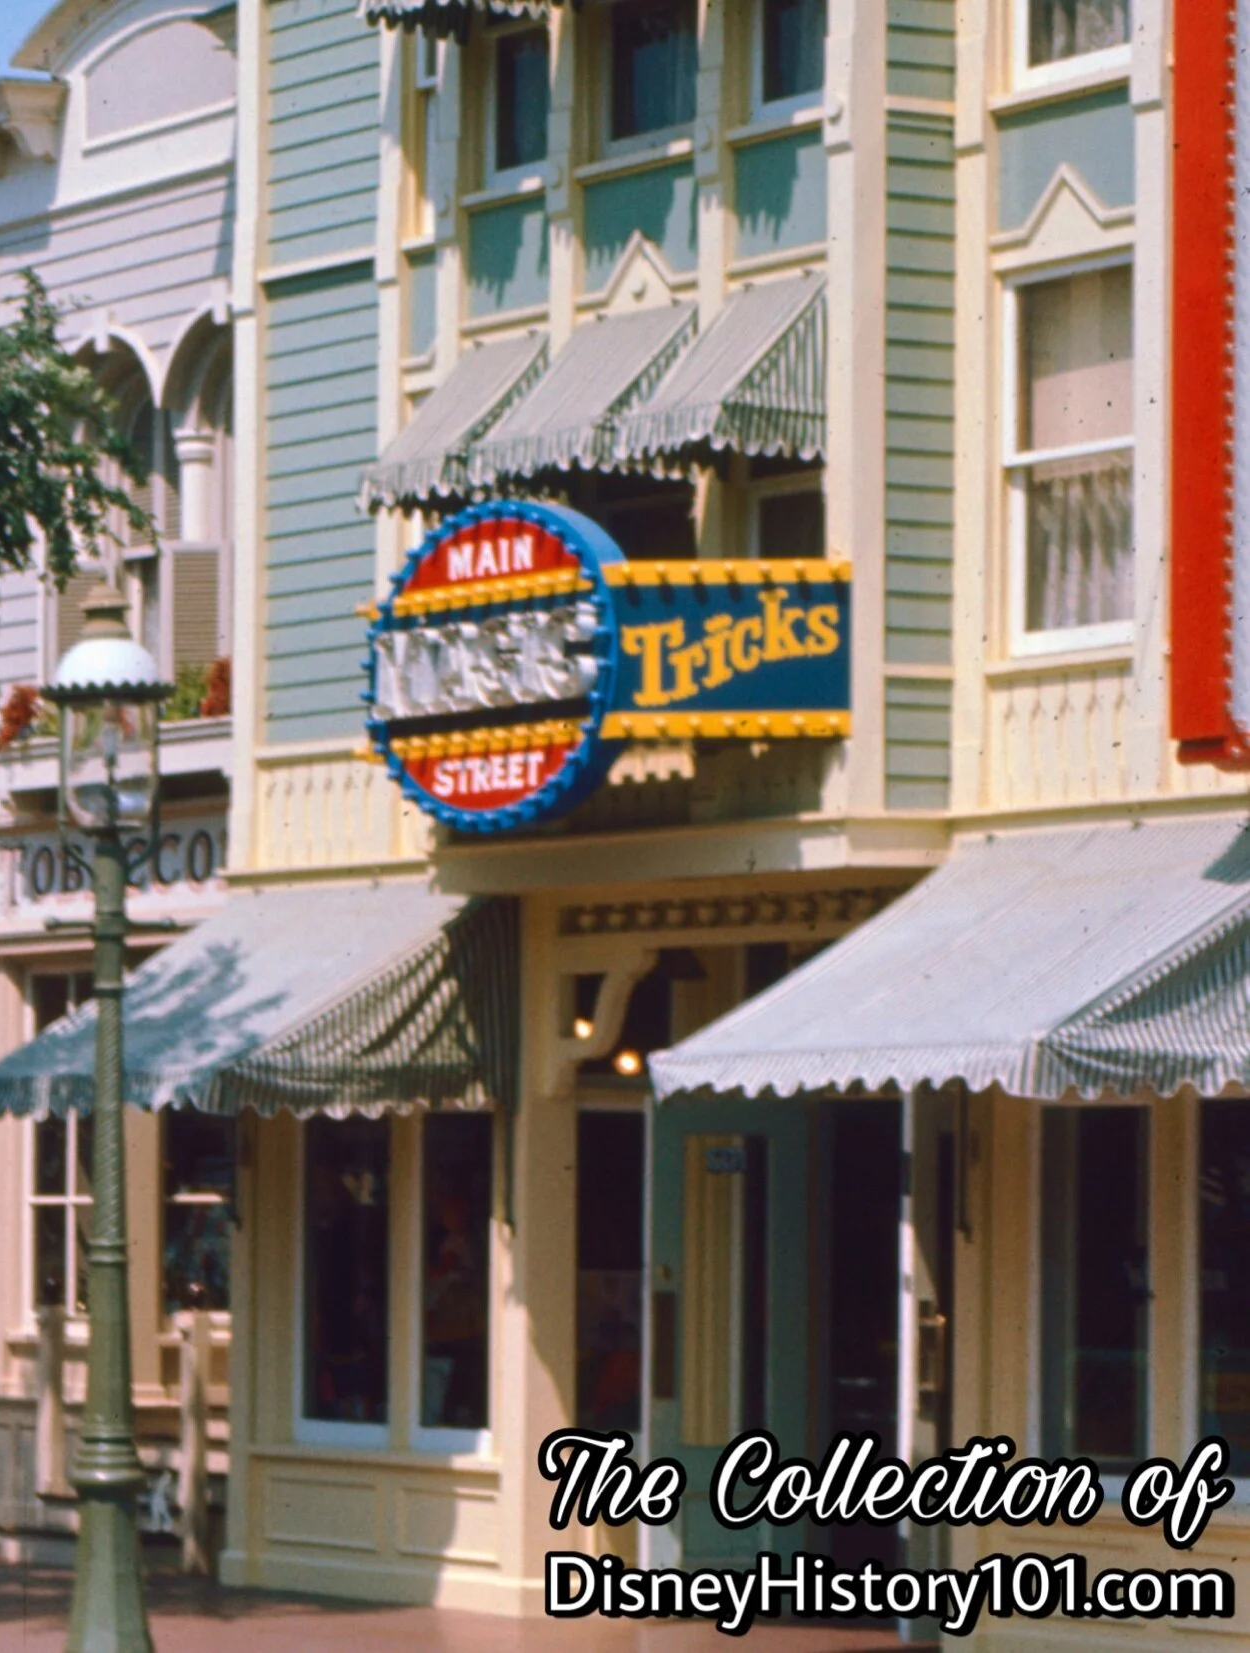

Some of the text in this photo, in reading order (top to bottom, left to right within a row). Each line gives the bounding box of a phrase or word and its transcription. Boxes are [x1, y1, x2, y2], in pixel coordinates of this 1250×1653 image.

[449, 535, 535, 580] MAIN
[621, 588, 840, 707] Tricks
[433, 751, 546, 798] STREET
